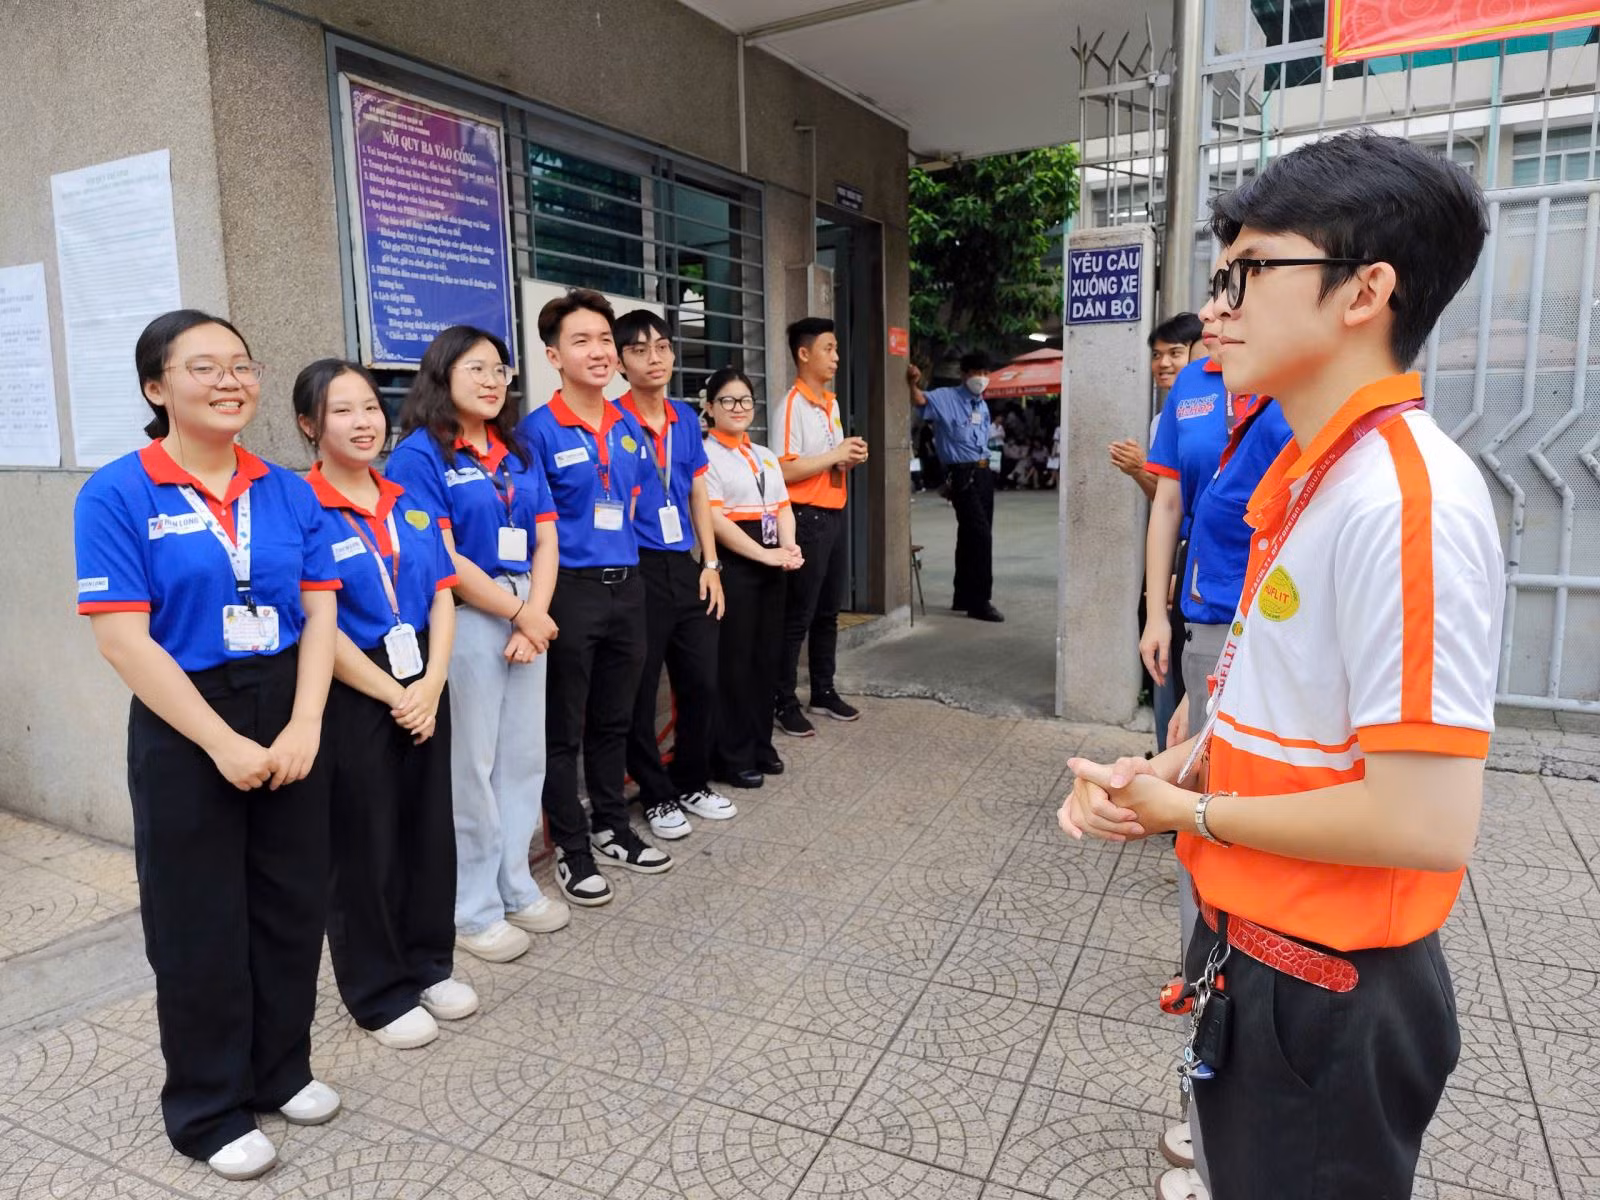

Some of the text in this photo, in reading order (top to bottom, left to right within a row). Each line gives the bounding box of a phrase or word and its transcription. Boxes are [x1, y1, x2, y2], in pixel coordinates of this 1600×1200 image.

[382, 130, 400, 148] NỘI
[401, 135, 420, 152] QUY
[421, 141, 434, 154] RA
[434, 144, 452, 161] VÀO
[1072, 250, 1140, 274] YÊU CẦU
[1072, 274, 1138, 298] XUỐNG XE
[1072, 296, 1135, 319] DẪN BỘ
[1250, 554, 1273, 594] FACULTY
[1270, 542, 1280, 556] OF
[1278, 506, 1302, 544] FOREIGN
[1300, 452, 1337, 509] LANGUAGES
